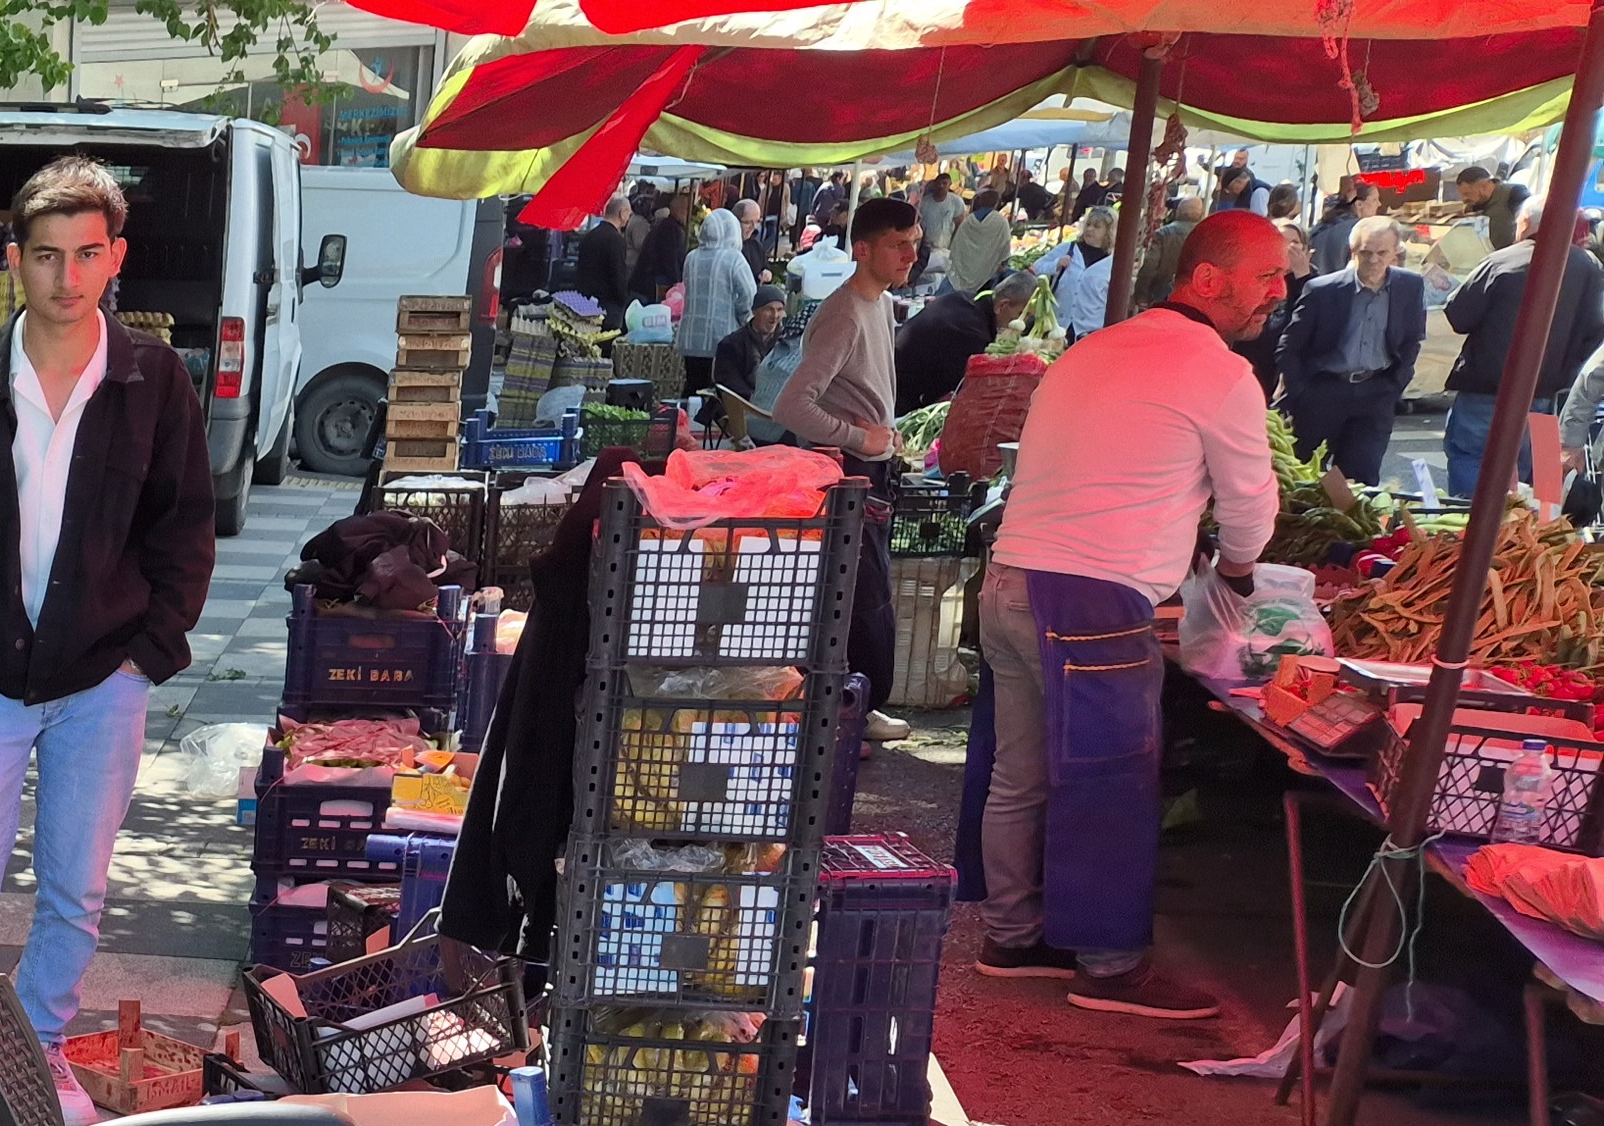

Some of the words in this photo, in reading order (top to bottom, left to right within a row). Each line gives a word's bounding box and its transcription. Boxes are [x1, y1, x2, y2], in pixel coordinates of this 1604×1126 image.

[328, 665, 363, 681] ZEKİ
[369, 669, 415, 682] BABA
[300, 835, 337, 851] ZEKİ
